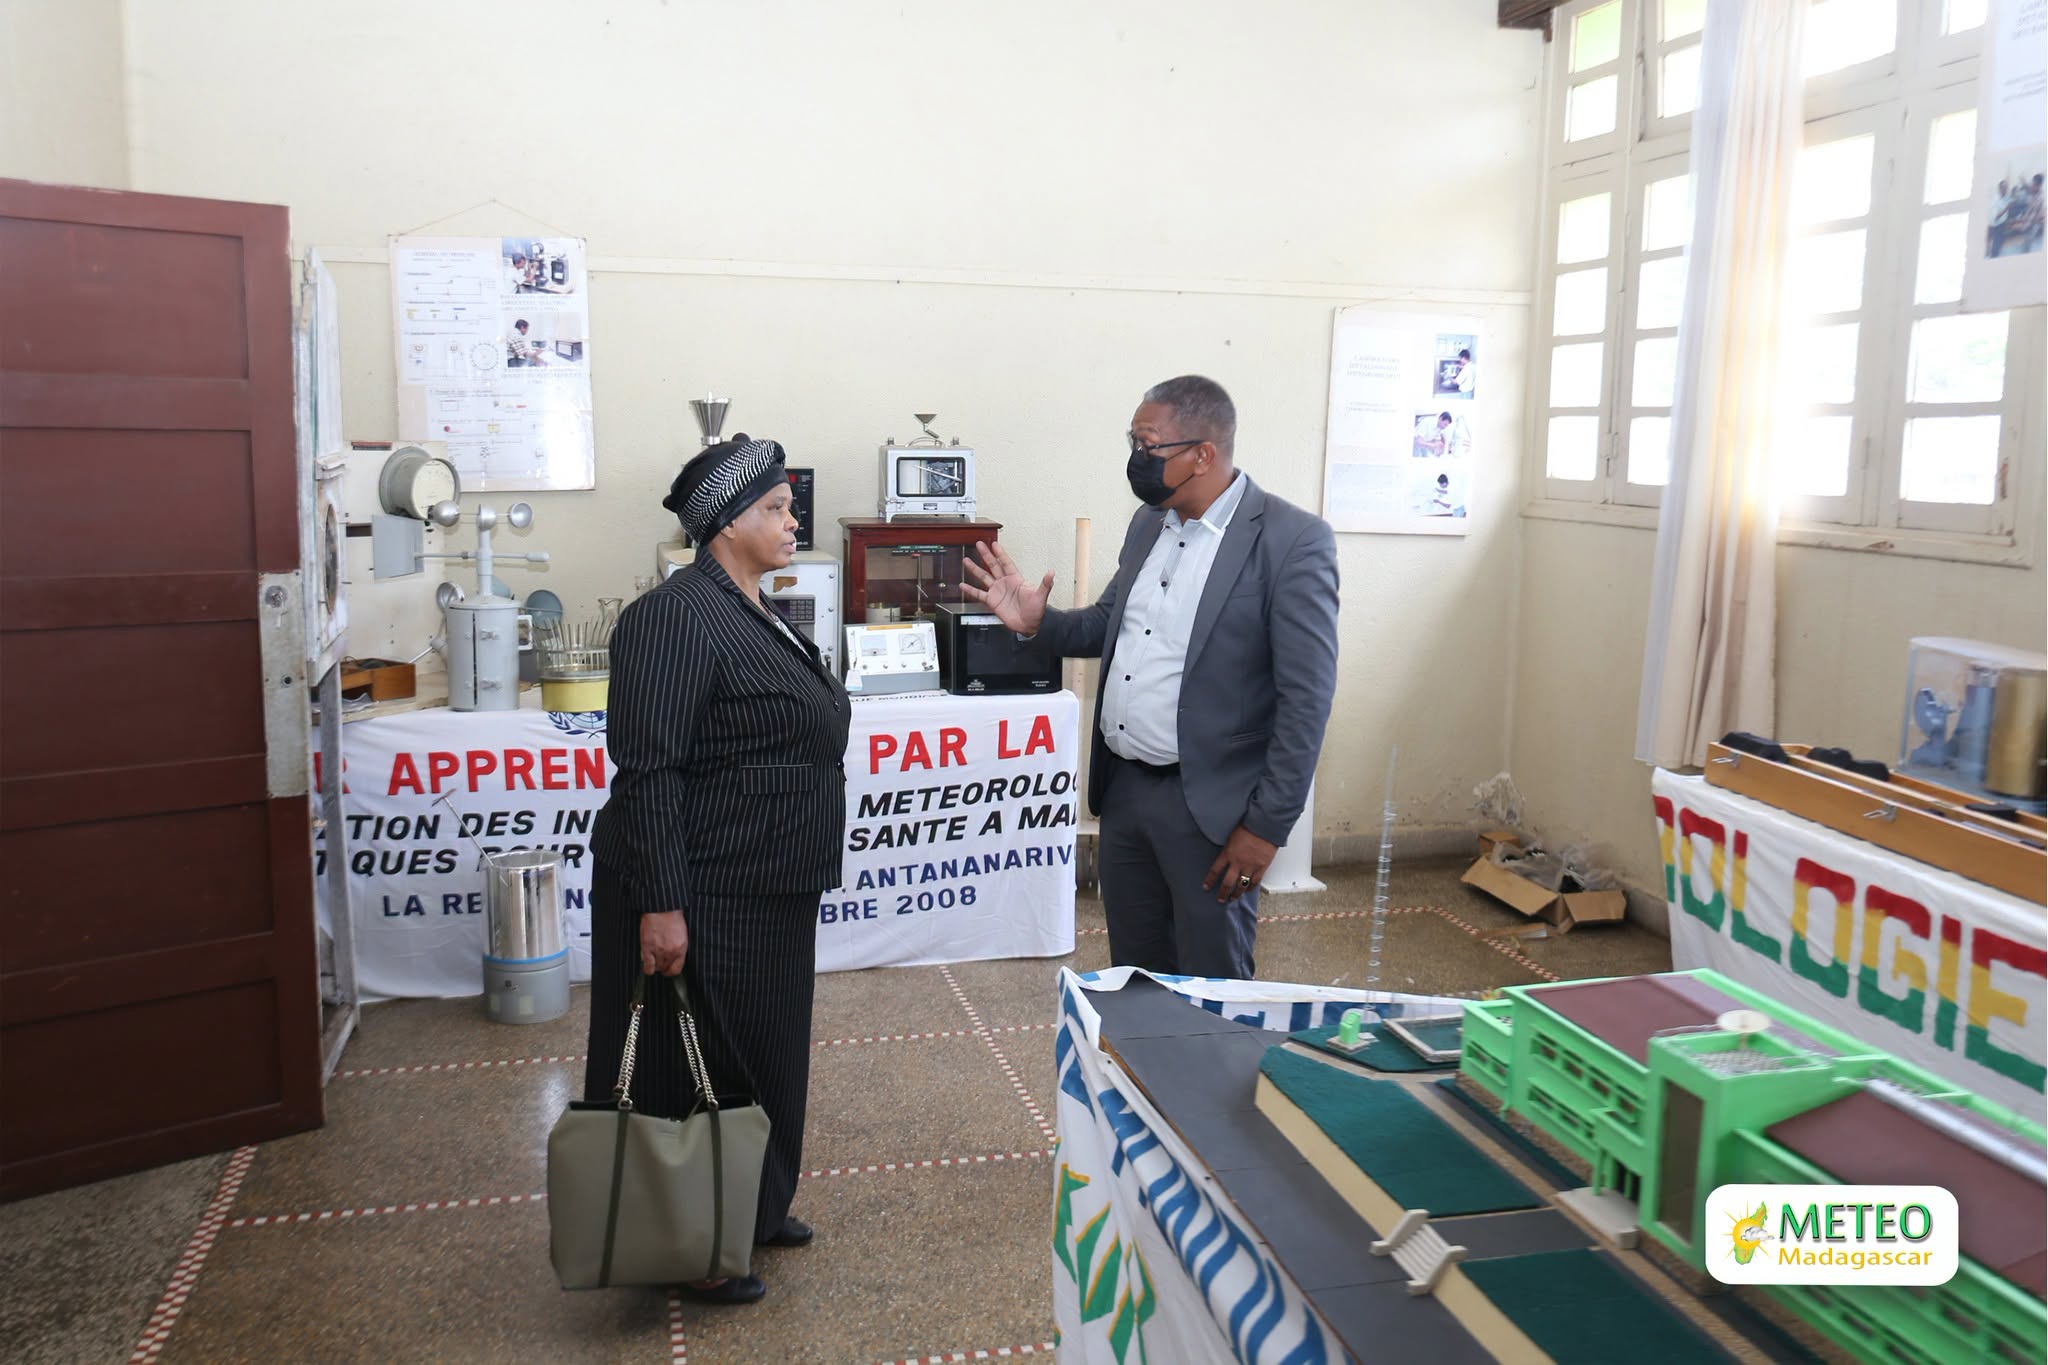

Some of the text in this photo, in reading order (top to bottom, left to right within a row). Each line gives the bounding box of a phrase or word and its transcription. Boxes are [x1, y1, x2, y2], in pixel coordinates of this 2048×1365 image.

[868, 726, 968, 775] PAR
[997, 714, 1056, 760] LA
[316, 814, 441, 841] TION
[458, 810, 537, 839] DES
[848, 815, 968, 852] SANTE
[978, 810, 1002, 836] A
[1017, 803, 1077, 830] MA
[383, 895, 426, 917] LA
[855, 843, 1077, 891] ANTANANARIV
[896, 884, 977, 915] 2008
